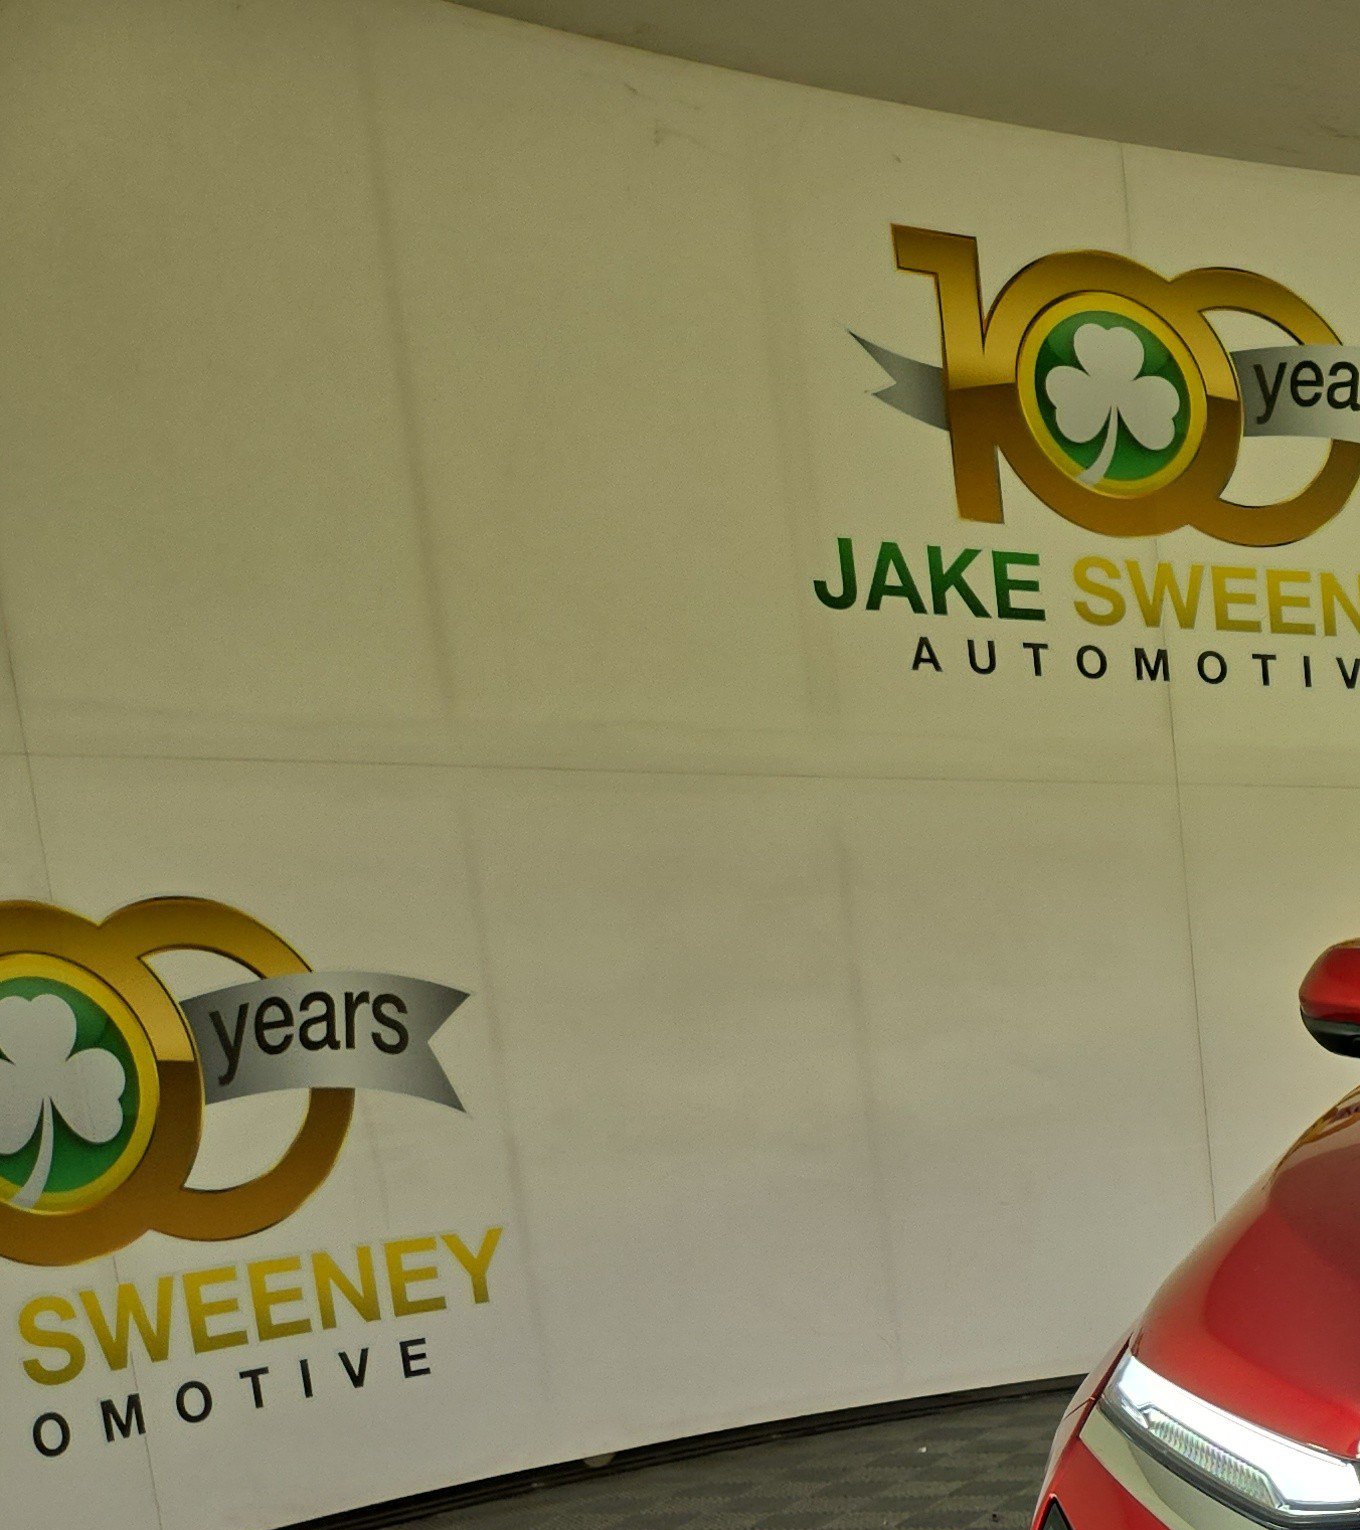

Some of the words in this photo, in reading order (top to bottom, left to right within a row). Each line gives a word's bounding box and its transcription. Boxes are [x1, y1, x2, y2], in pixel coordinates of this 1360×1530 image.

[812, 537, 1046, 622] JAKE
[209, 990, 410, 1086] years
[17, 1227, 503, 1386] SWEENEY
